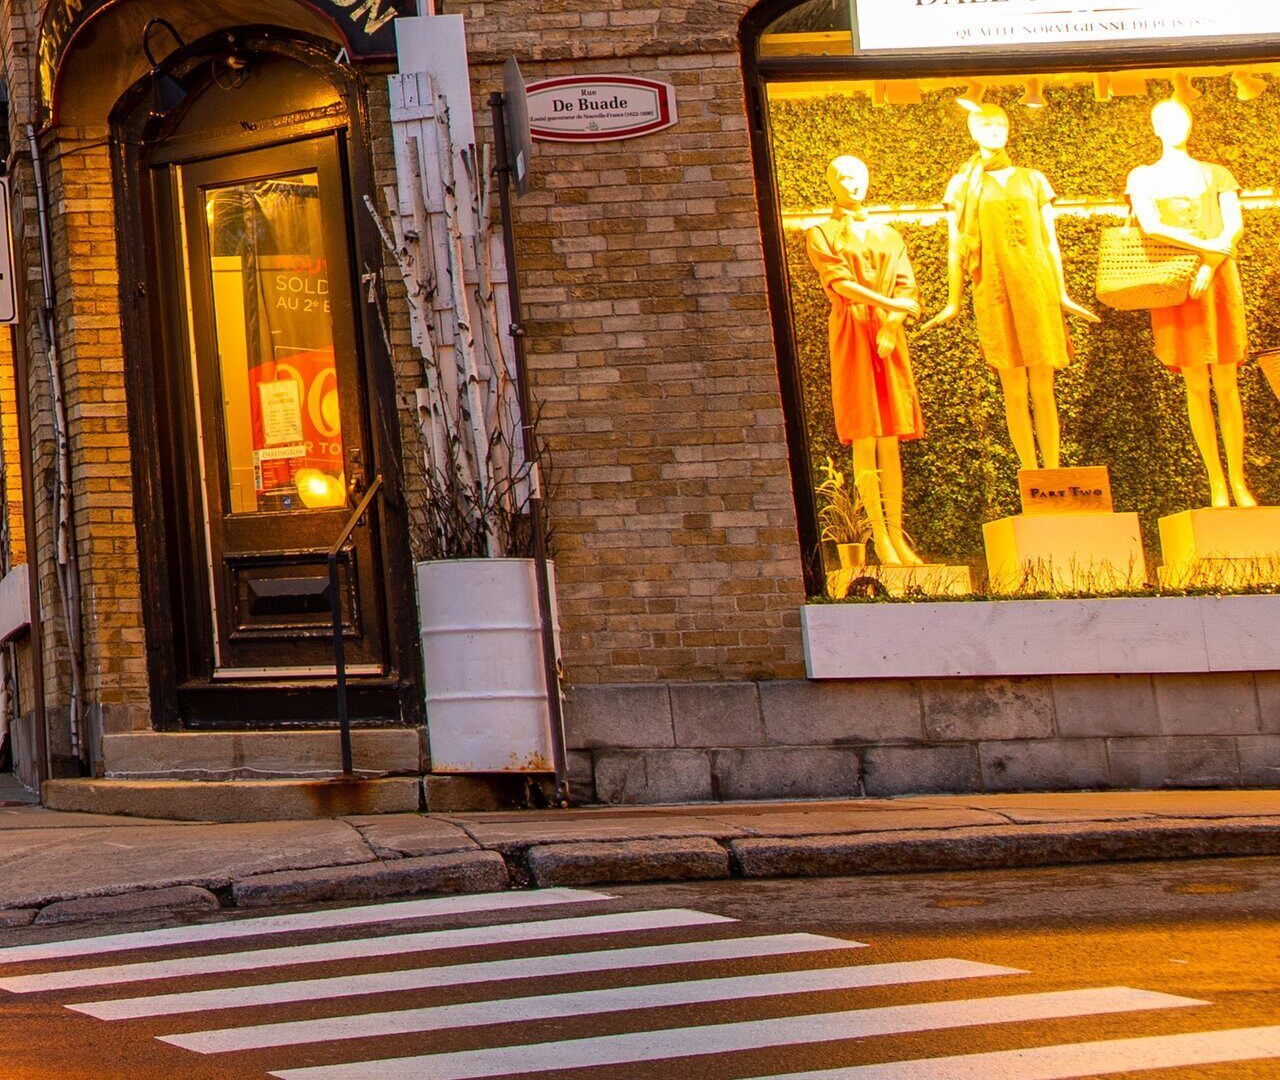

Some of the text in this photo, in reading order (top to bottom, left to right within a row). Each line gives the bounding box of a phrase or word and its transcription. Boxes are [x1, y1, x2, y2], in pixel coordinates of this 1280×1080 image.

[580, 88, 597, 96] Rue
[552, 95, 628, 113] De Buade
[276, 296, 299, 310] AU
